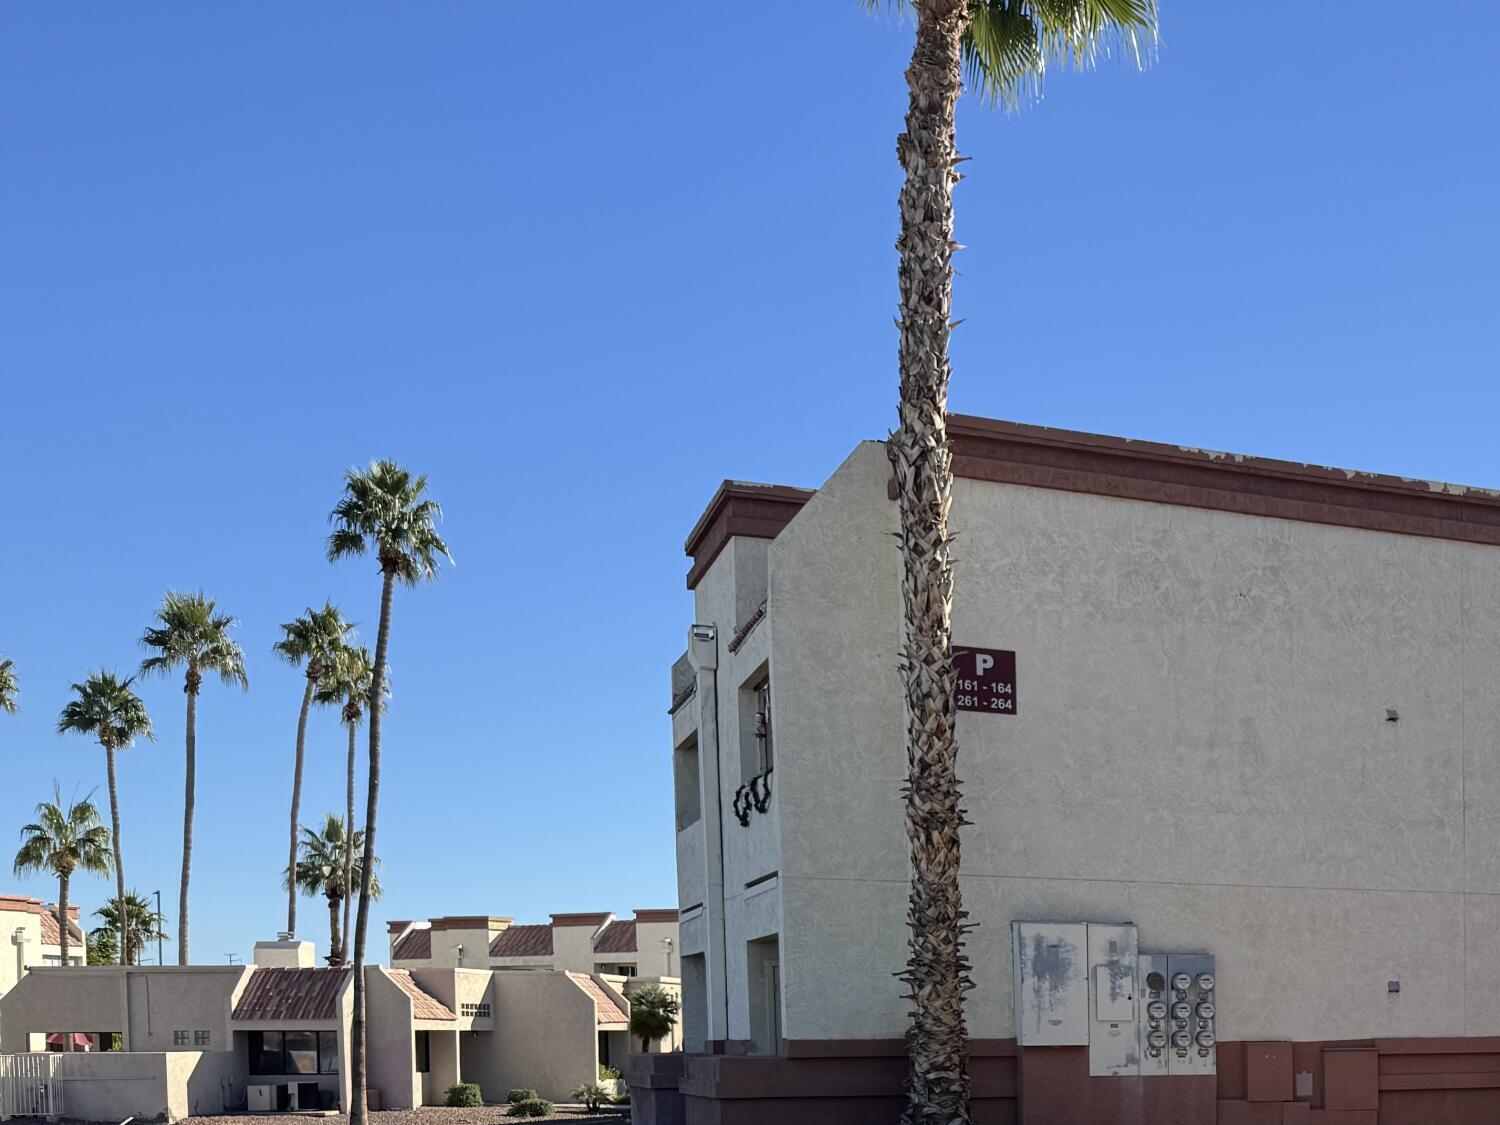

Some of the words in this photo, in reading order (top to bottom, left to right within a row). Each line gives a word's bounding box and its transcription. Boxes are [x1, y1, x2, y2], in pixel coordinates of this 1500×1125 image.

[976, 653, 994, 676] P
[958, 679, 978, 691] 161
[991, 682, 1012, 694] 164
[957, 695, 978, 707] 261
[991, 698, 1012, 709] 264
